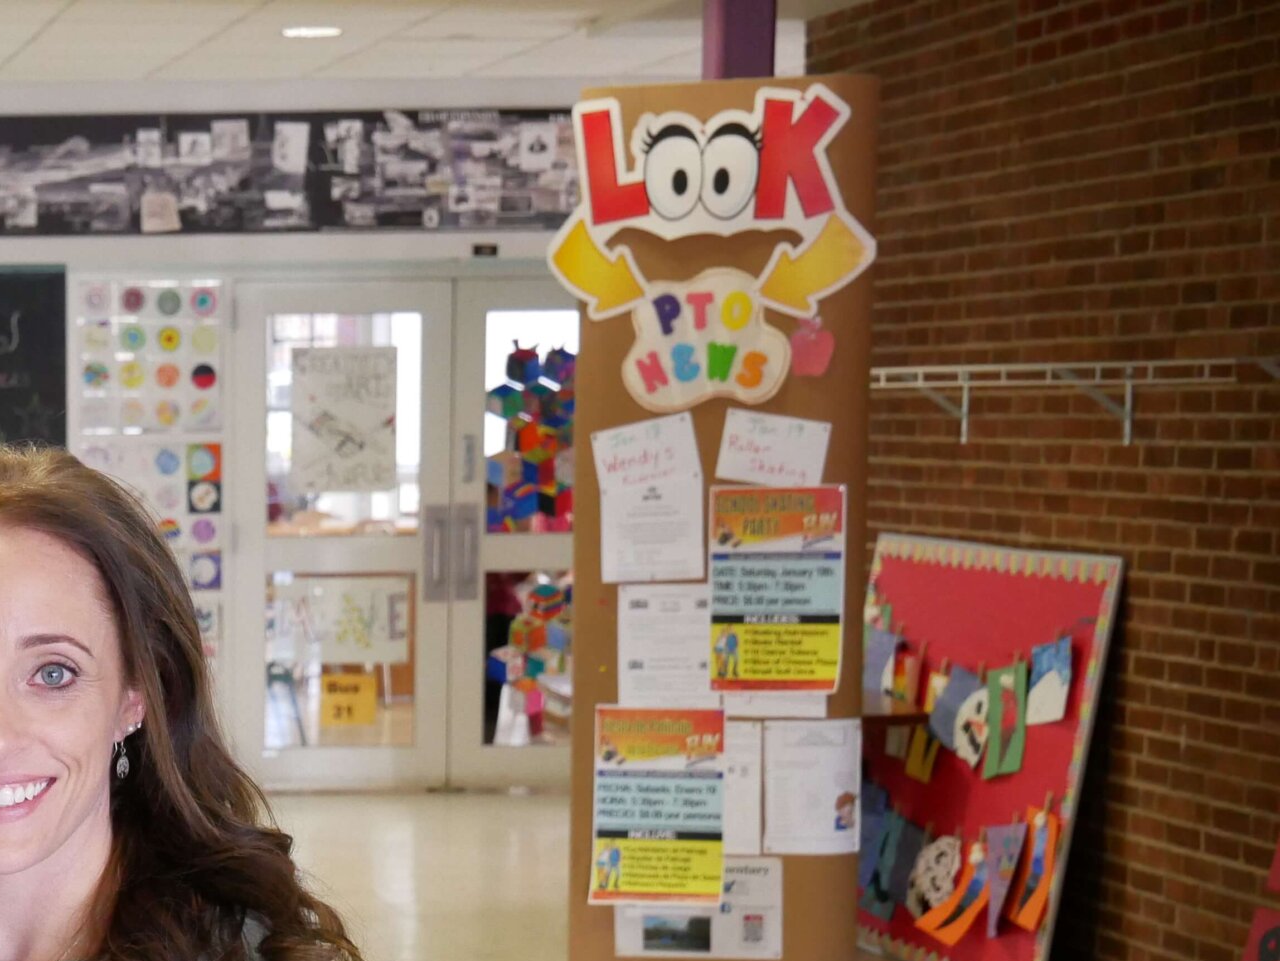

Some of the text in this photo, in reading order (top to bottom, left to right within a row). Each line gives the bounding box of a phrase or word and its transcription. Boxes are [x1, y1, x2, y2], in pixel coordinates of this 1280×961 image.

[581, 94, 841, 226] LOOK
[652, 290, 754, 336] PTO
[634, 340, 769, 394] NEWS
